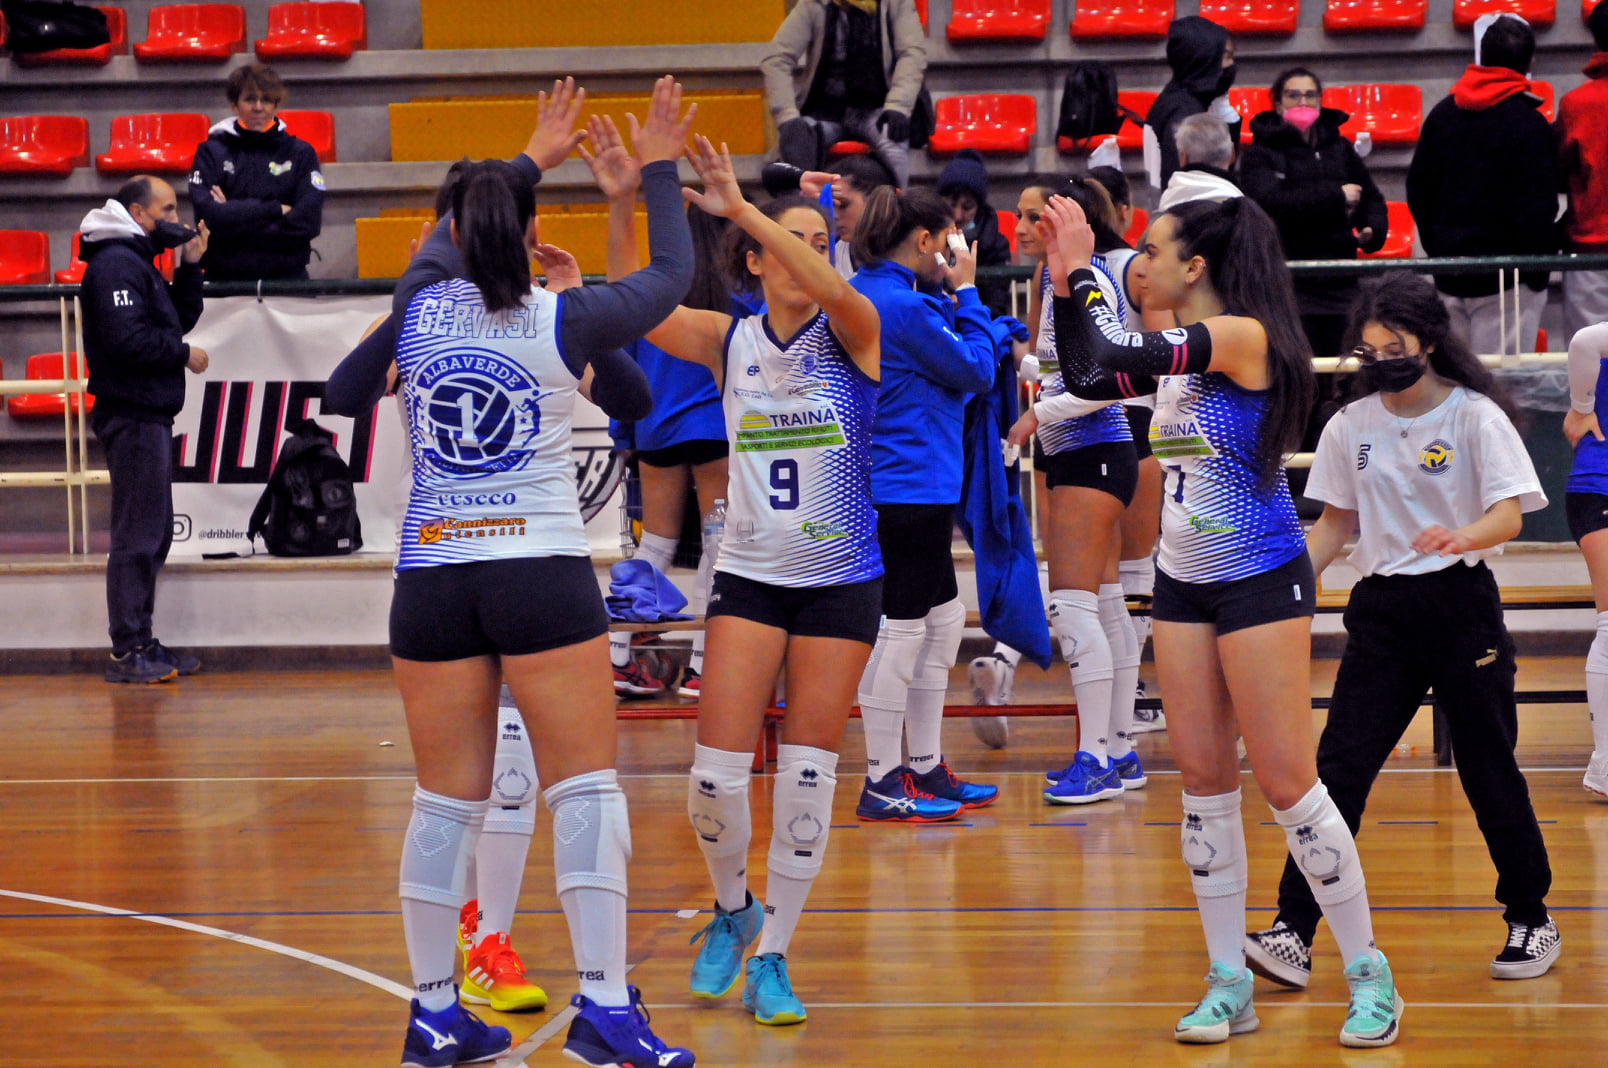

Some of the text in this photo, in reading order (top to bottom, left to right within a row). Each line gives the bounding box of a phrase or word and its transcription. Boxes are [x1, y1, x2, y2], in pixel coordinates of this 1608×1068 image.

[113, 290, 133, 306] F.T.
[416, 298, 539, 338] GERVASI
[422, 356, 521, 388] ALBAVERDE
[456, 392, 480, 447] 1
[770, 408, 836, 427] TRAINA
[1160, 422, 1198, 438] TRAINA
[1357, 444, 1372, 470] 5
[769, 459, 799, 510] 9
[444, 517, 526, 531] Cannizzaro
